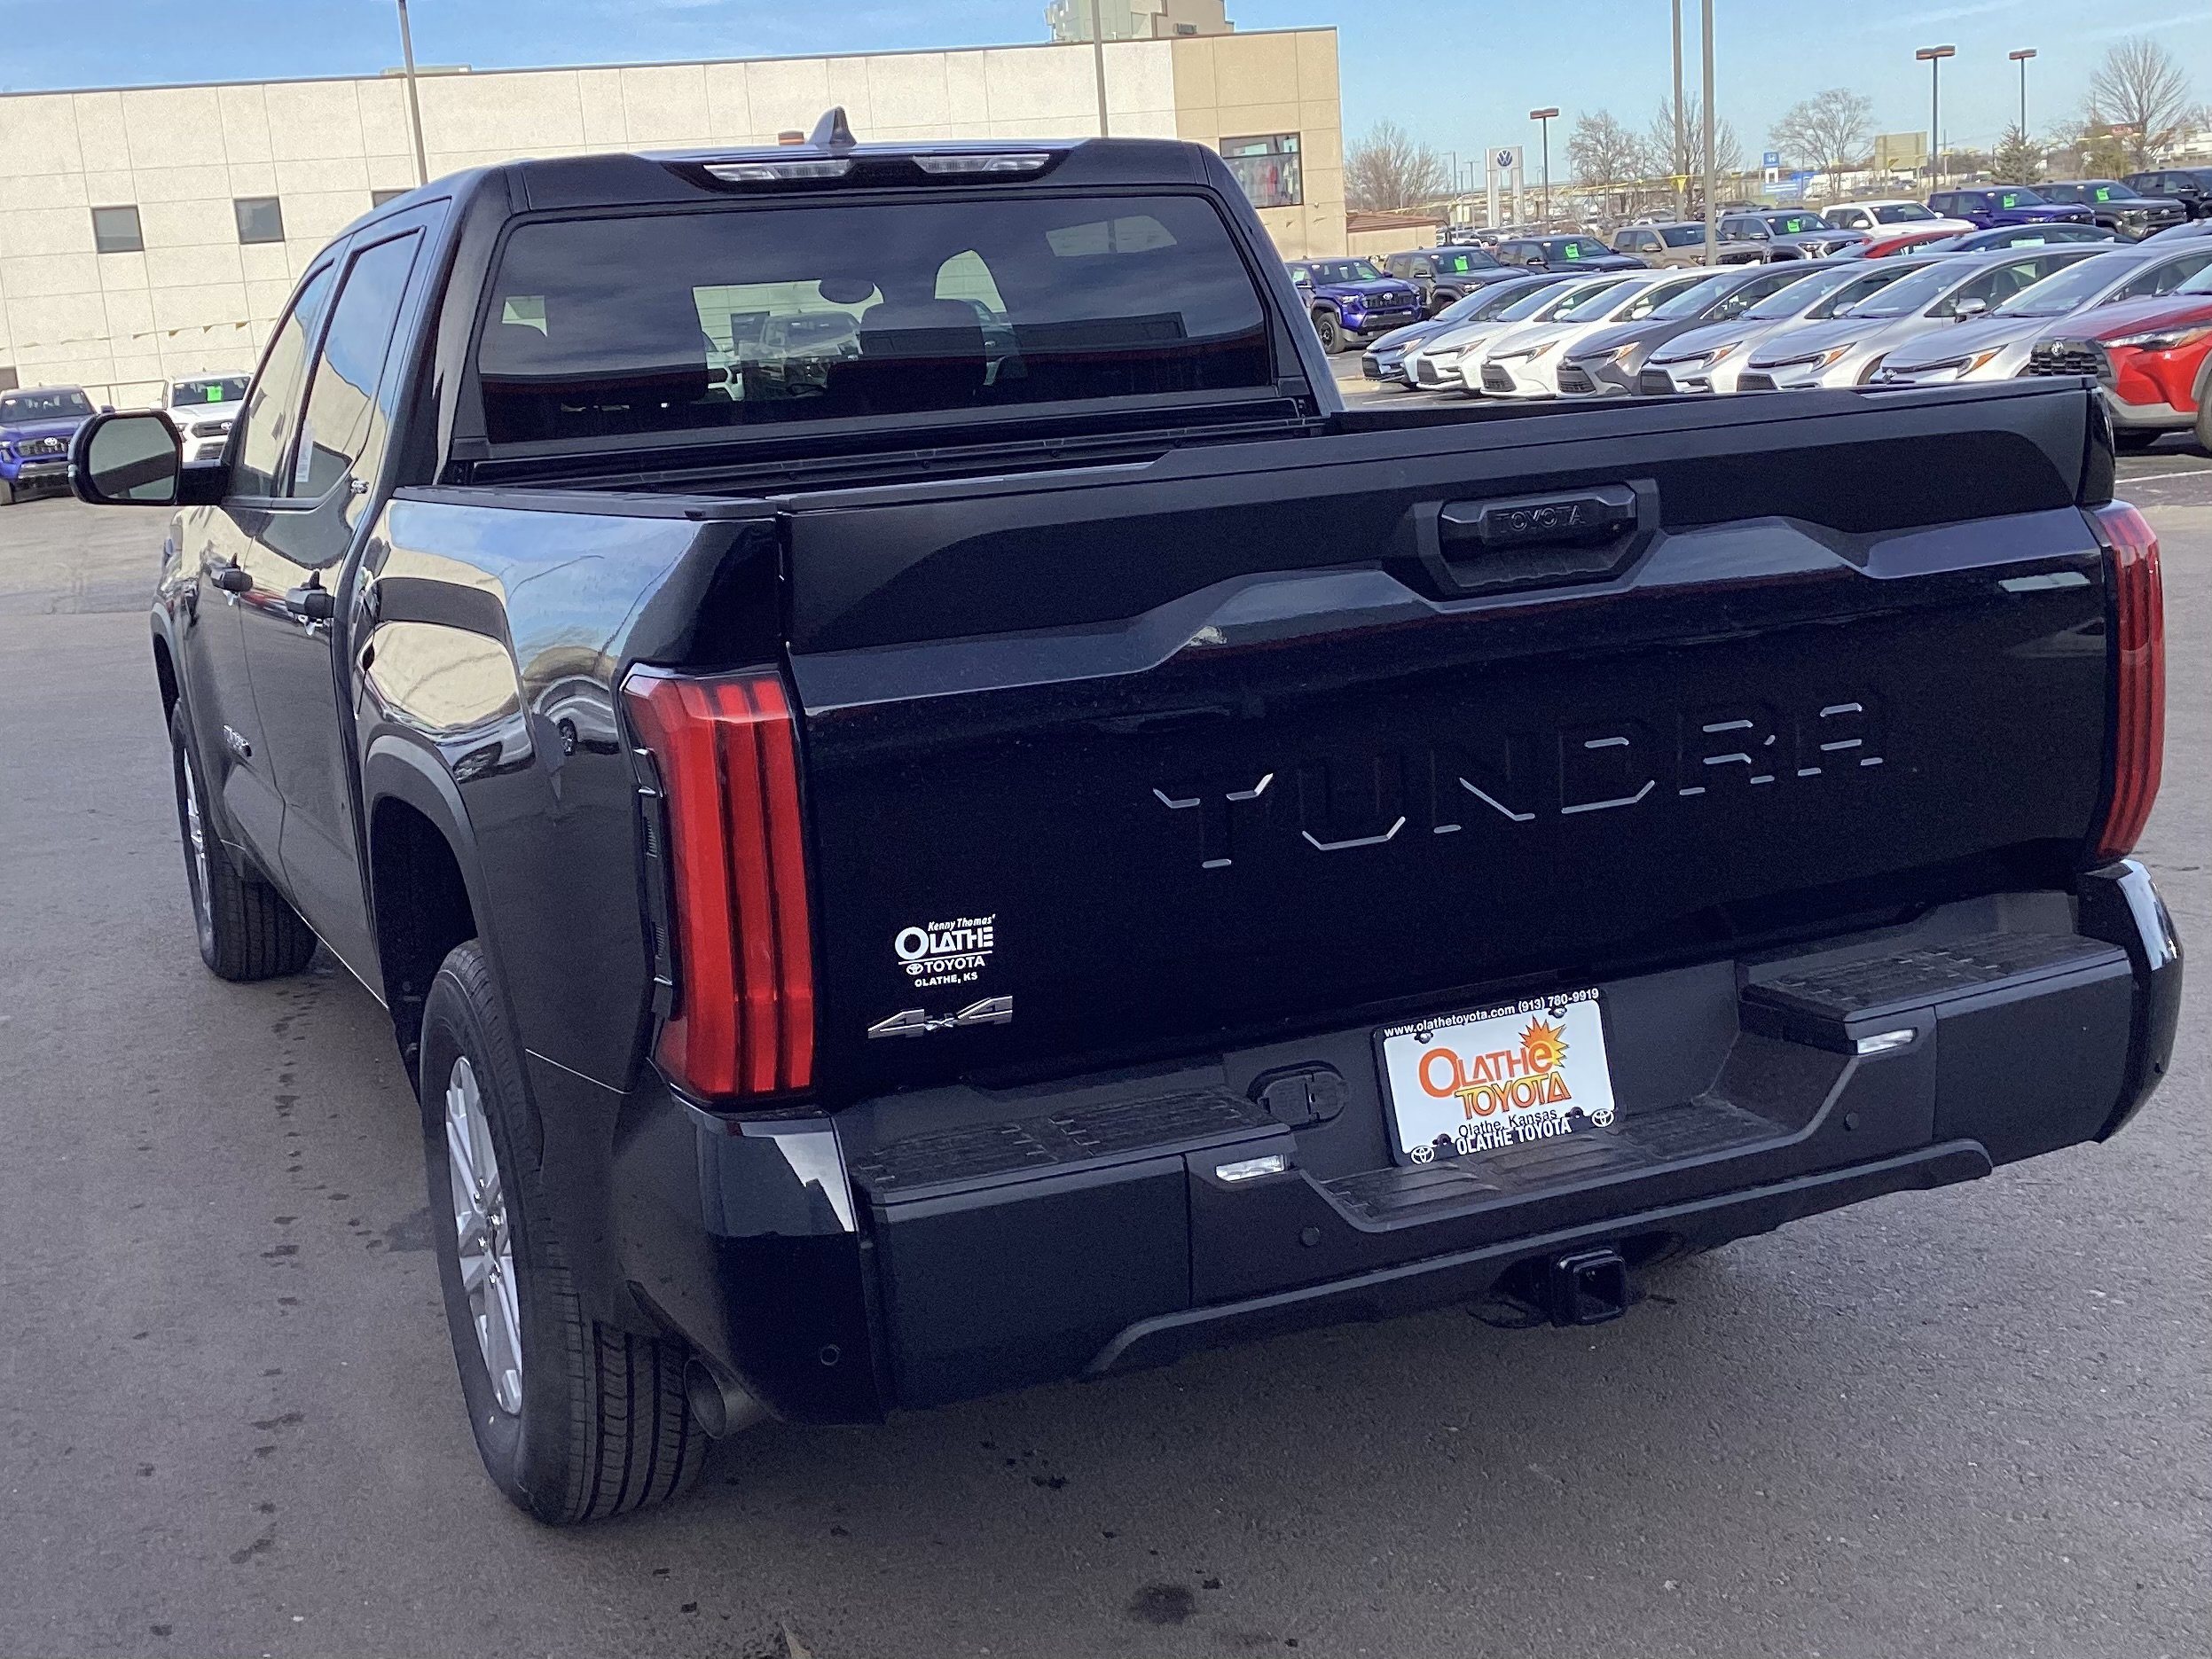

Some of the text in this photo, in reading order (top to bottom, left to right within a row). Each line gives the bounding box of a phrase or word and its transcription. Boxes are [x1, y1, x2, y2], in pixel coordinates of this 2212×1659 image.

[1494, 505, 1586, 532] TOYOTA
[1150, 693, 1886, 866] TUNDRA
[927, 919, 956, 932] Kenny
[894, 926, 994, 960] OLATHE
[914, 971, 978, 988] OLATHE, KS
[924, 955, 985, 974] TOYOTA
[1384, 988, 1600, 1037] www.olathetoyota.com (913) 780-9919
[1455, 1071, 1573, 1121] TOYOTA
[1508, 1109, 1557, 1129] Kansas
[1455, 1117, 1573, 1155] OLATHE TOYOTA
